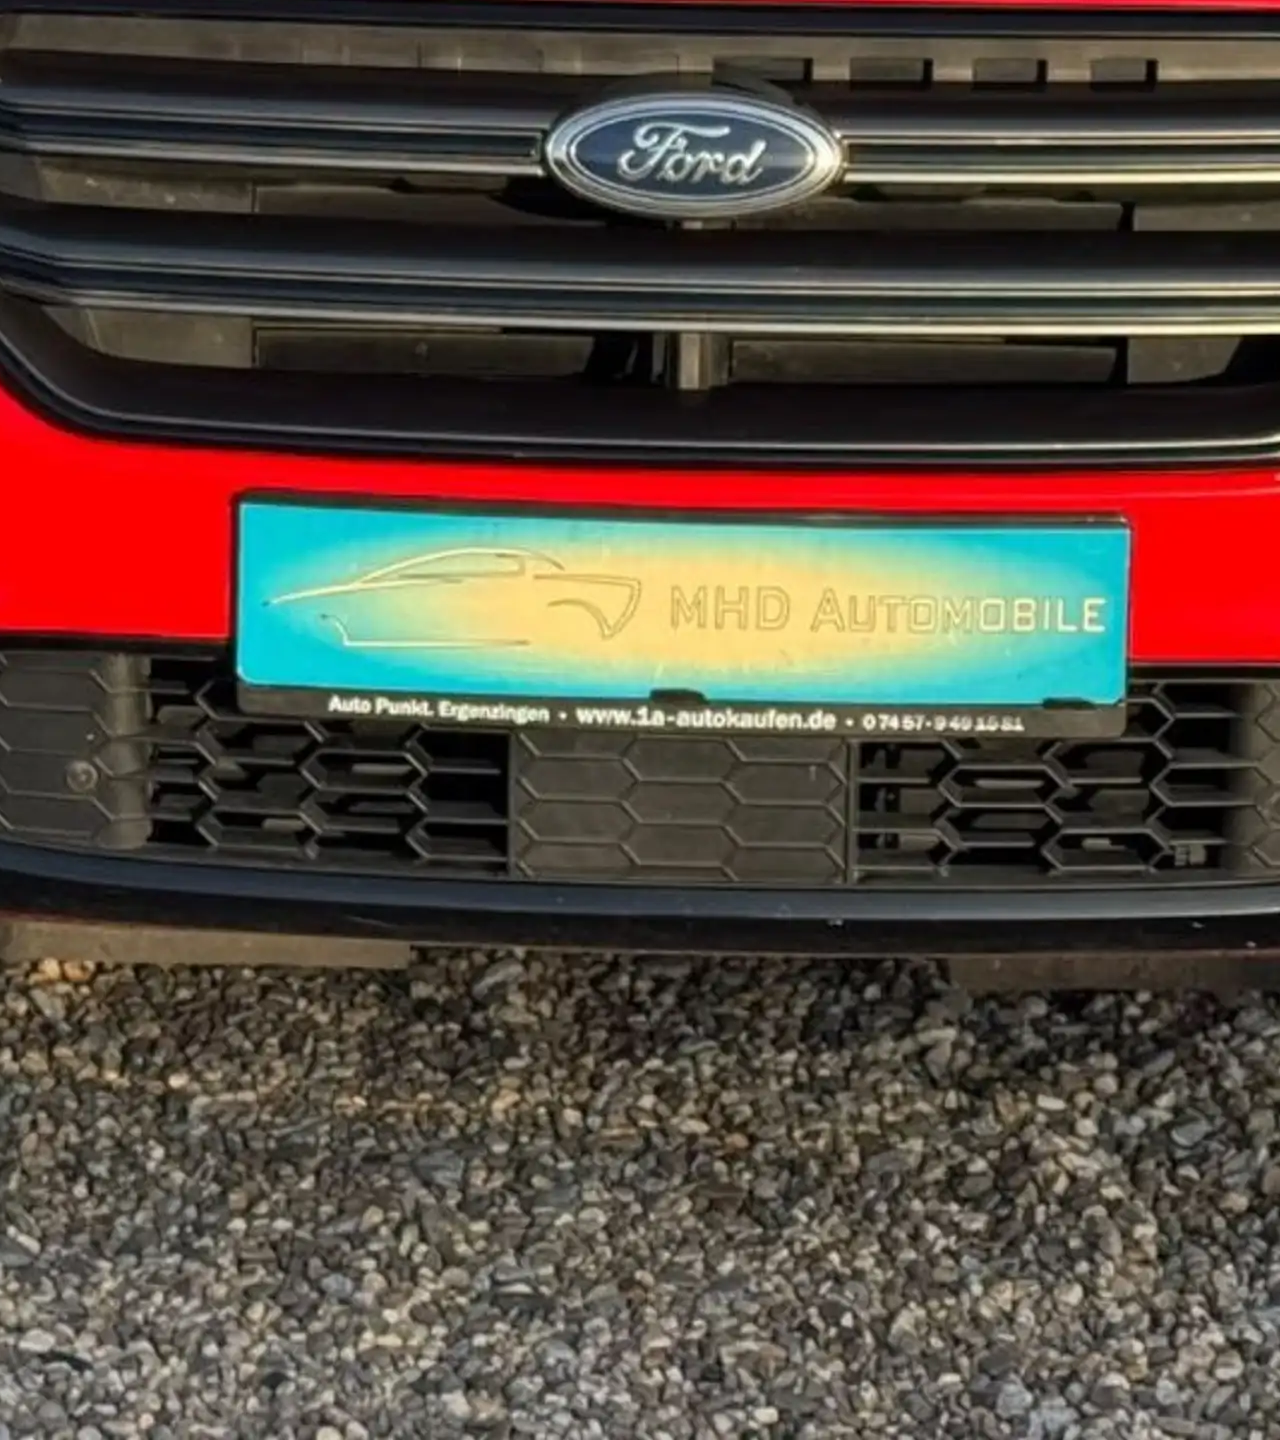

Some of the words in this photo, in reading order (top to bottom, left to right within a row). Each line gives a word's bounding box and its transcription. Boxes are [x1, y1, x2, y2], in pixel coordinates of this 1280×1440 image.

[618, 122, 767, 184] Ford
[669, 586, 791, 631] MHD
[328, 694, 372, 714] Auto
[438, 700, 550, 724] Ergenzingen
[576, 706, 837, 730] www.1a-autokaufen.de
